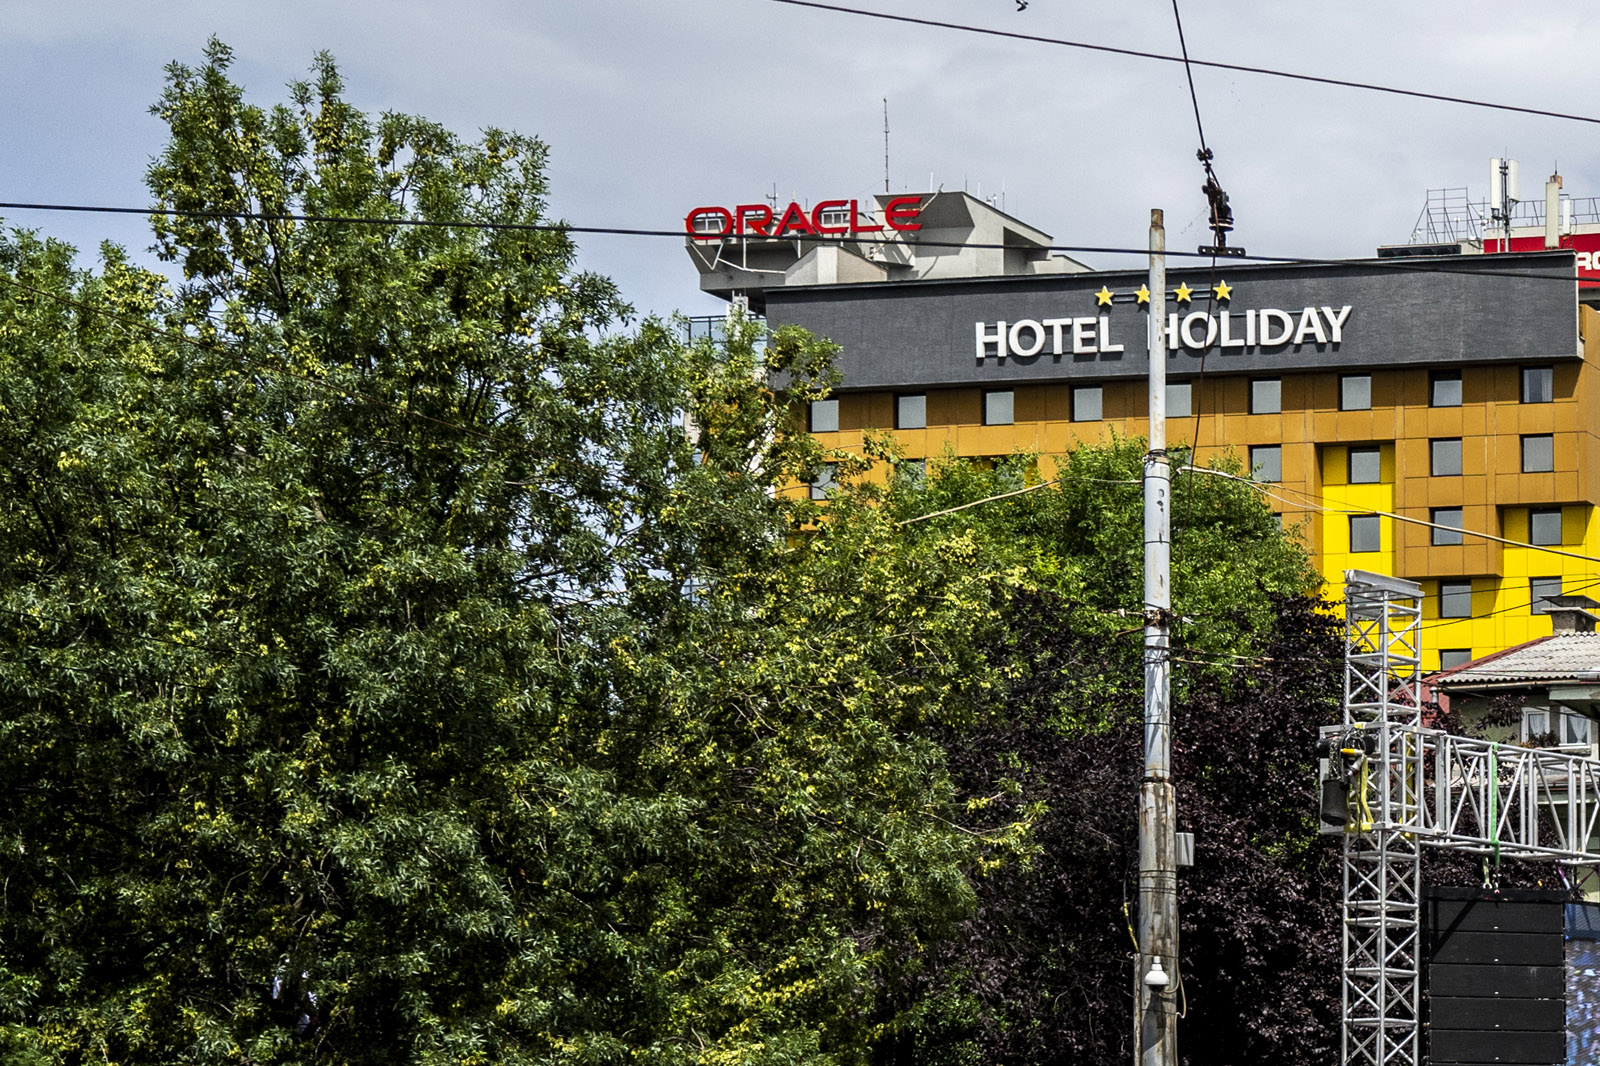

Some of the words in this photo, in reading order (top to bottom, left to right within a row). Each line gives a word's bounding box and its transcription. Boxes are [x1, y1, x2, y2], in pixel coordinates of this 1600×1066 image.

[686, 196, 922, 240] ORACLE
[975, 315, 1124, 358] HOTEL
[1147, 305, 1352, 350] HOLIDAY
